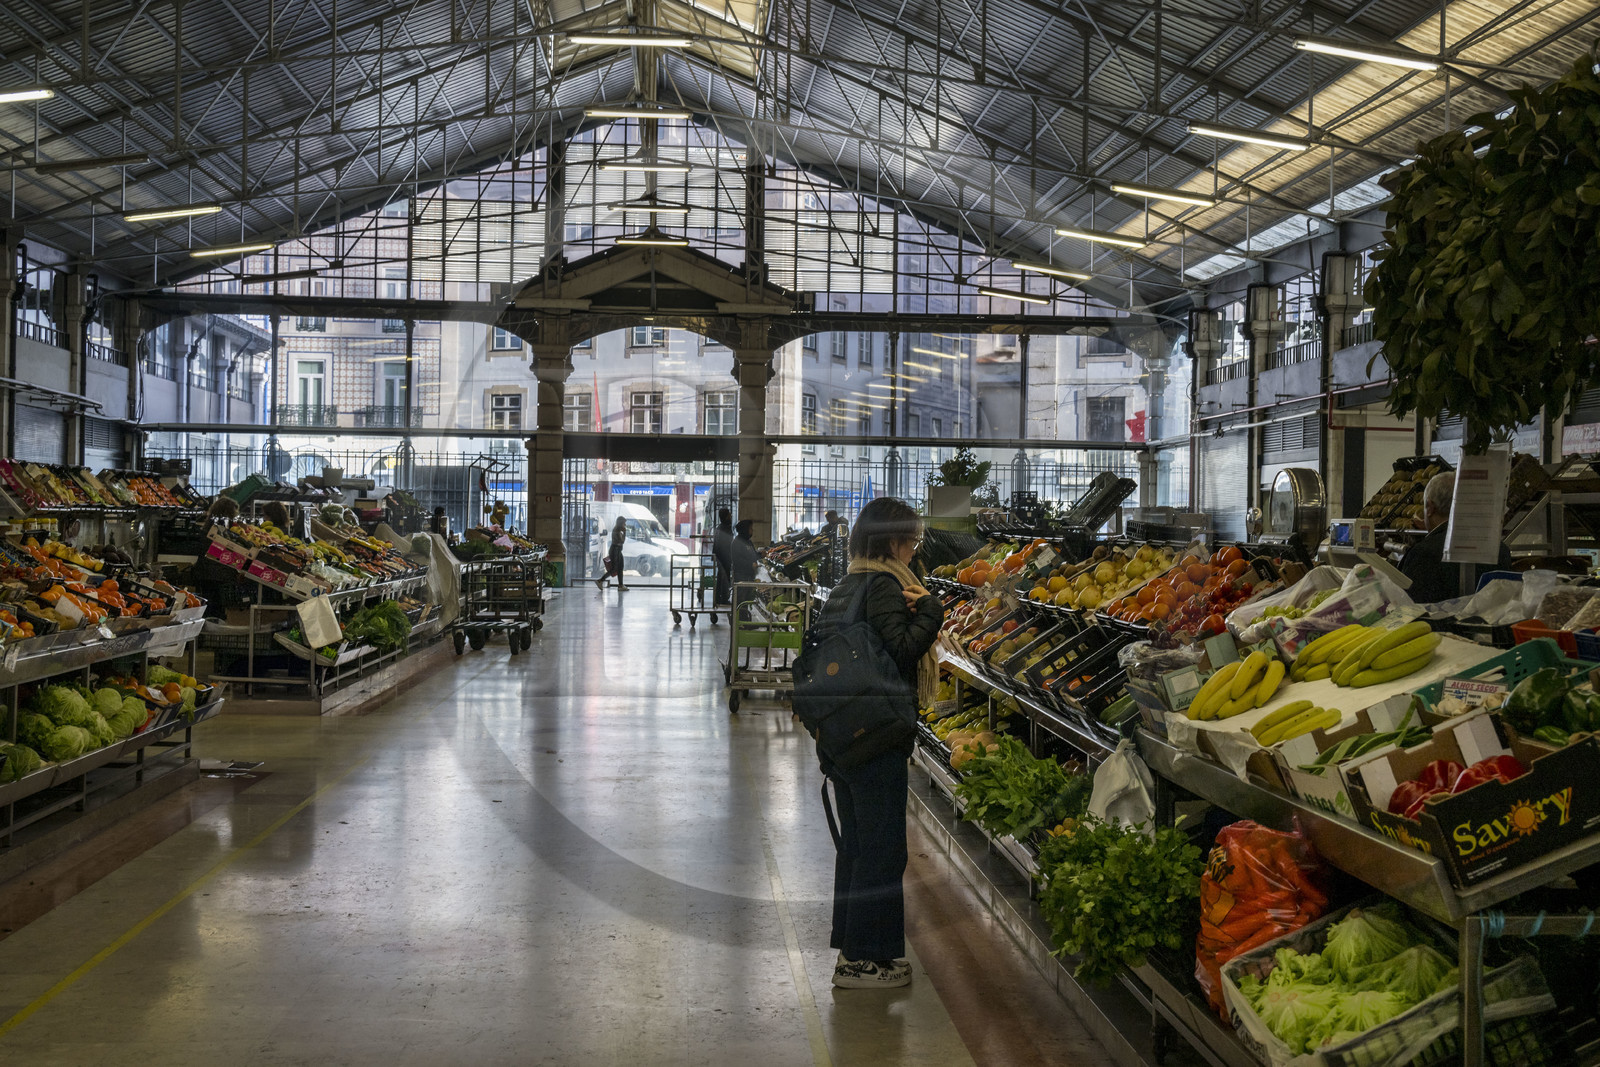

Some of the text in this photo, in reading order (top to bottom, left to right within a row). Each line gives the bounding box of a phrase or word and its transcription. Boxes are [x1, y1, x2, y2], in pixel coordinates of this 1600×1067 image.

[1451, 681, 1499, 693] ALHOS SECOS
[1453, 786, 1572, 856] Savory
